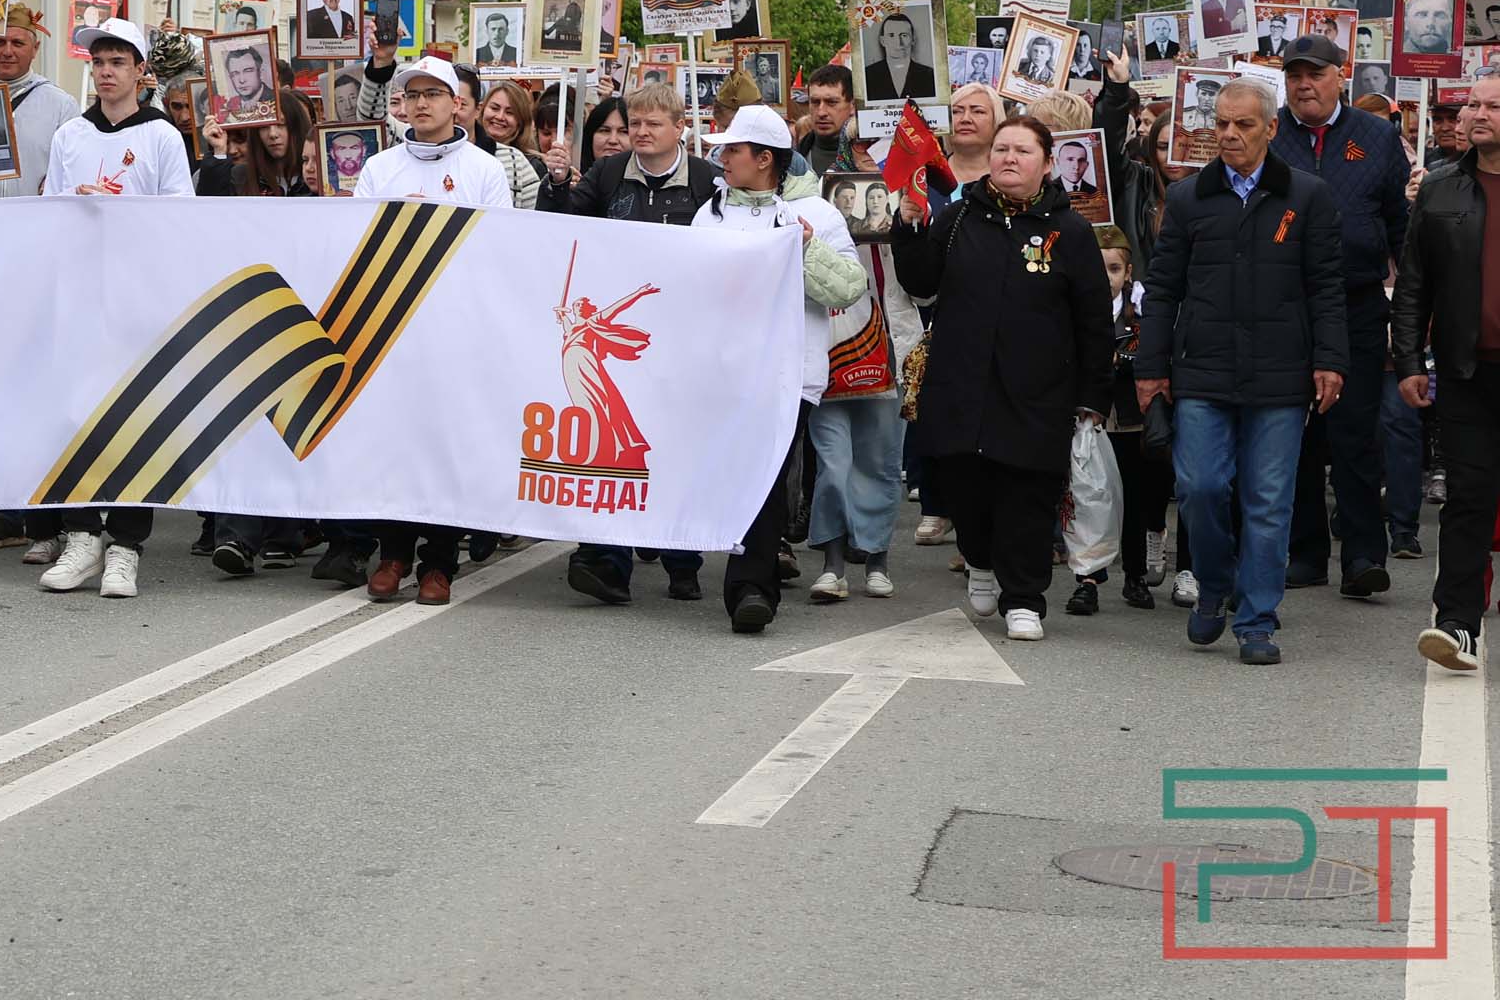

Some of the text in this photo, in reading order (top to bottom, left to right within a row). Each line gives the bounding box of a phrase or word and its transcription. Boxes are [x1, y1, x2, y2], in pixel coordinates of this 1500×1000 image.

[847, 368, 881, 382] ВАМИН
[521, 402, 592, 466] 80
[518, 471, 649, 514] ПОБЕДА!
